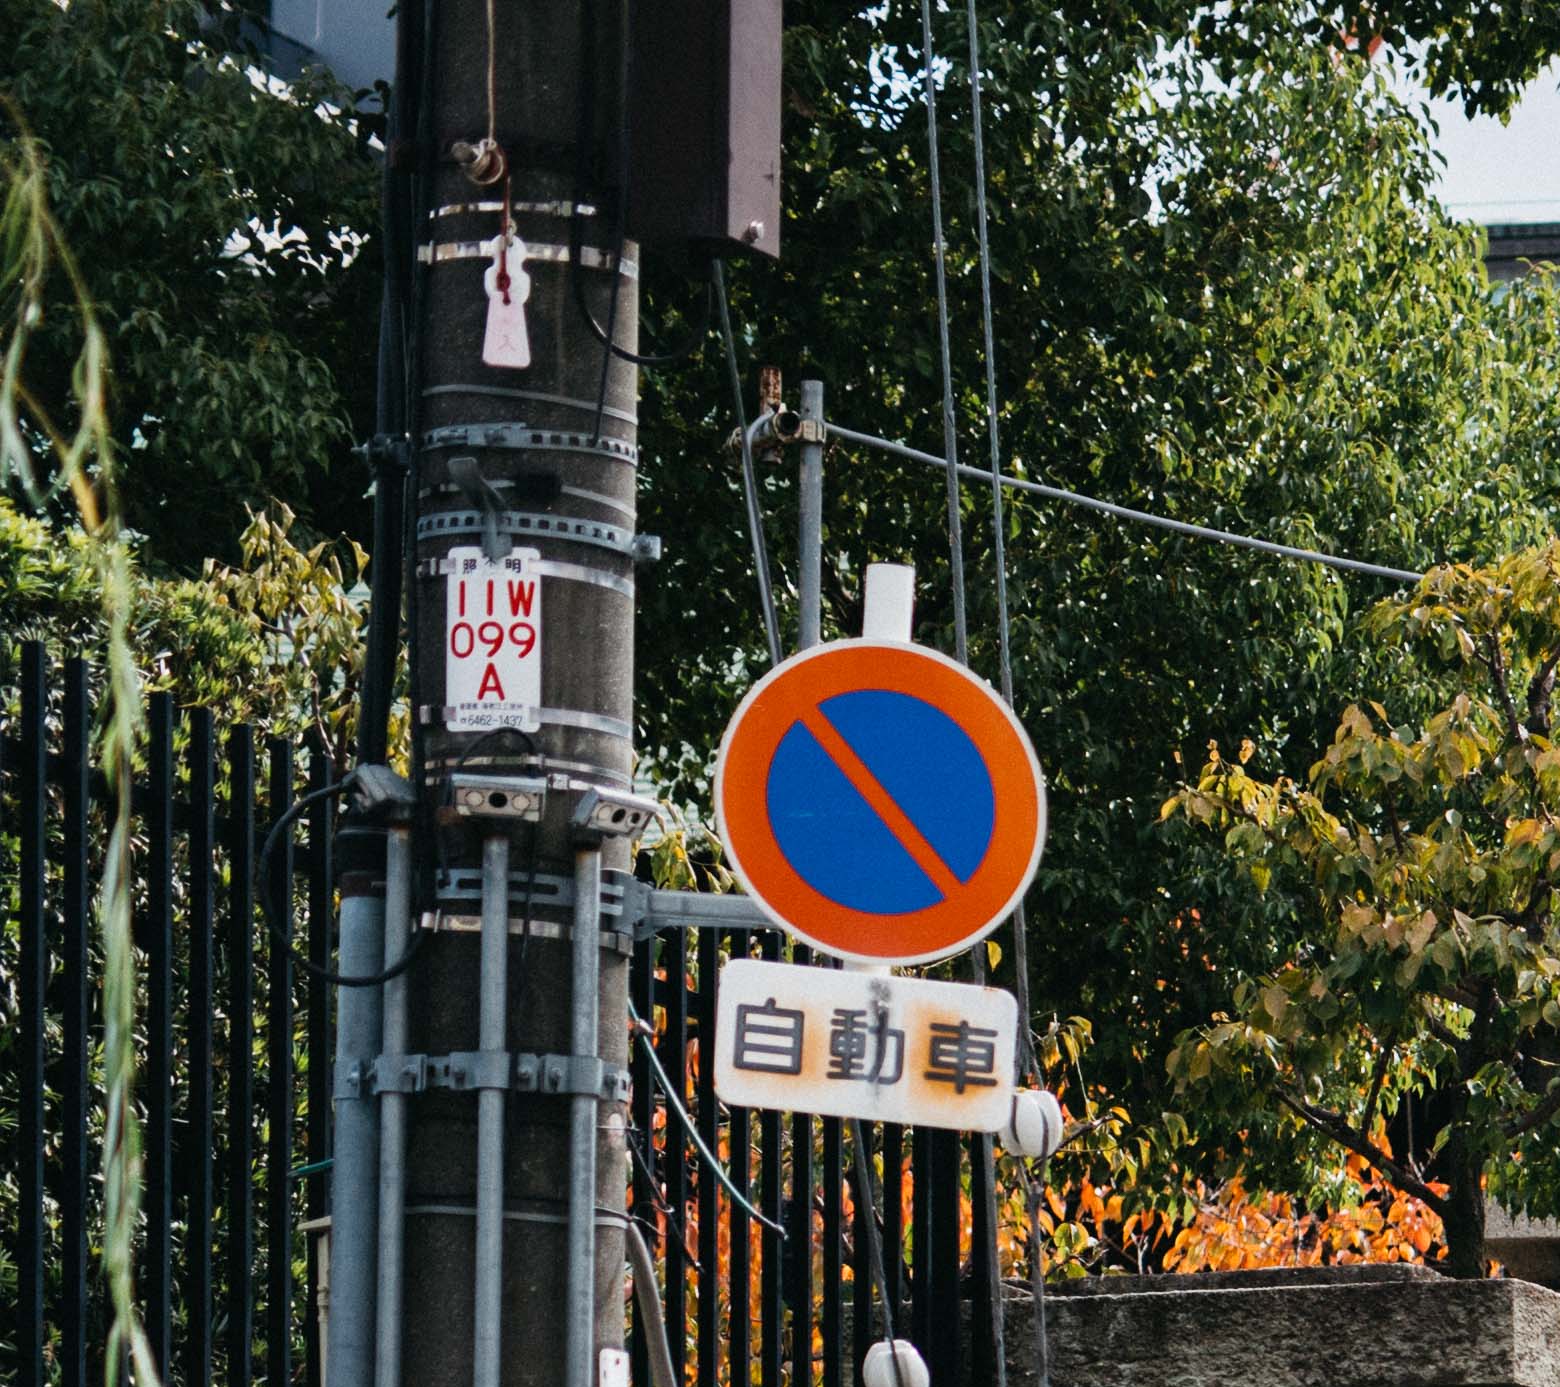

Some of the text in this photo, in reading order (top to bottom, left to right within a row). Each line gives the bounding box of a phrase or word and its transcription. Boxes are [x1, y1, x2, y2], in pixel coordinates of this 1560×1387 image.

[451, 621, 536, 659] 099
[477, 662, 506, 702] A
[733, 996, 998, 1095] 自動車
